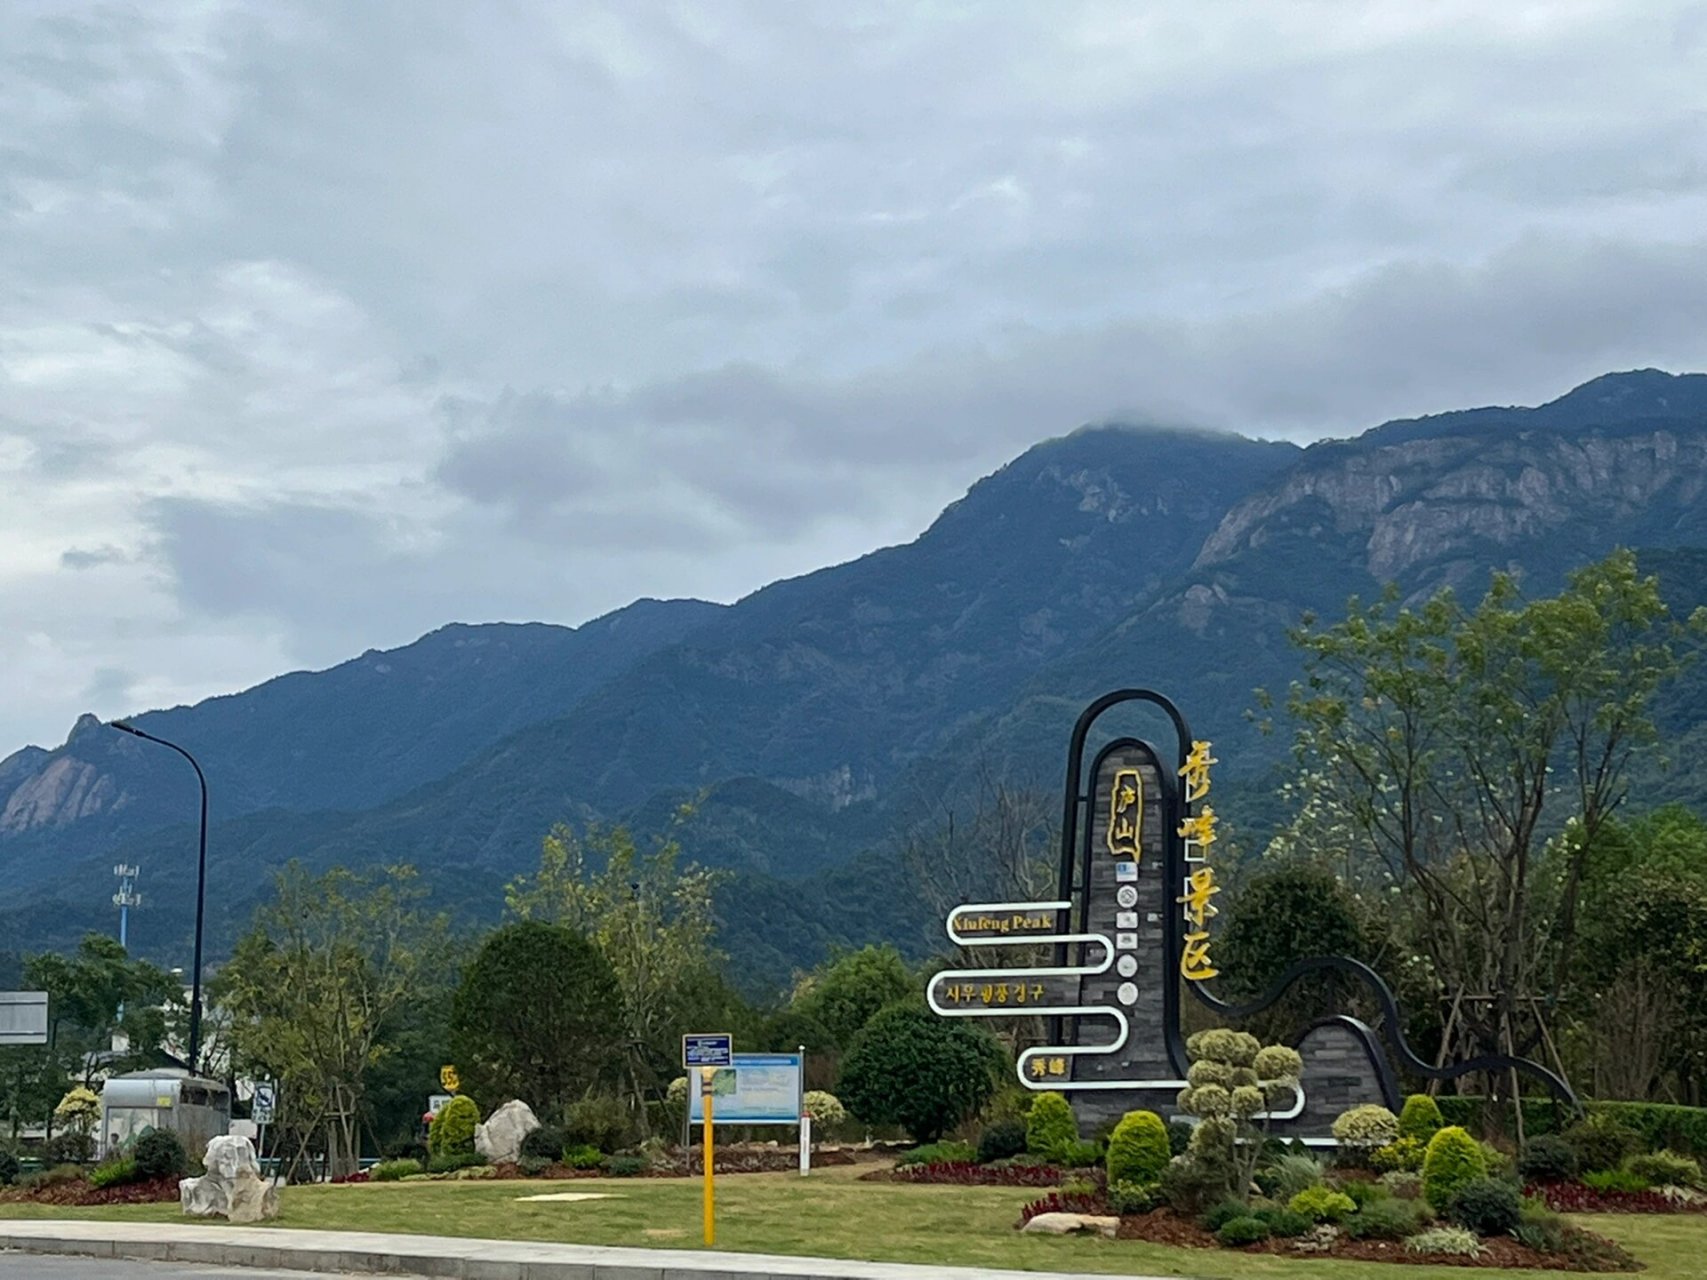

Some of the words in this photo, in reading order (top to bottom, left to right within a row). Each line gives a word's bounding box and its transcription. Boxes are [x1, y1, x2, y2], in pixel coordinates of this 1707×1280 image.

[1116, 784, 1136, 840] 庐山
[1177, 740, 1220, 980] 秀峰景区
[1012, 914, 1052, 929] Peak
